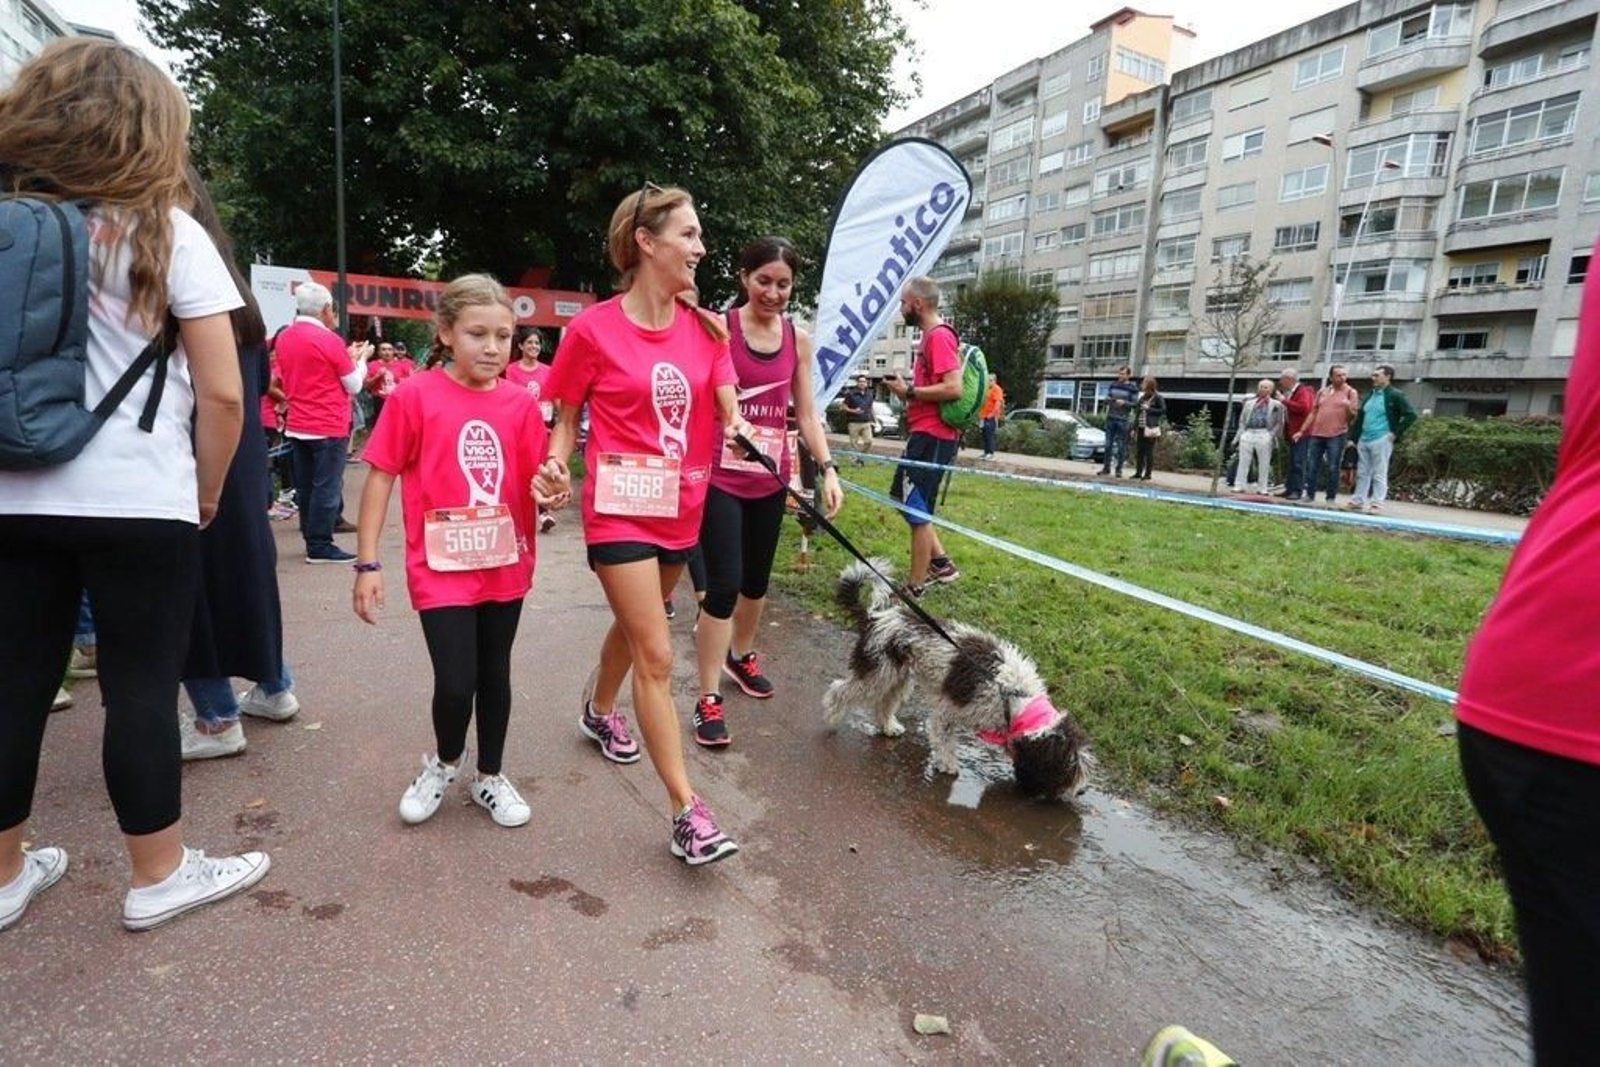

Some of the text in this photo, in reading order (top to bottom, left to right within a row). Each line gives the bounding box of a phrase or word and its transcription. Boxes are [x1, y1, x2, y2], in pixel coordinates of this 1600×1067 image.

[815, 181, 956, 391] Atlántico
[332, 282, 442, 312] RUNRU
[658, 385, 685, 396] VIGO
[739, 404, 784, 417] UNNIN
[469, 427, 485, 440] VI
[465, 446, 495, 456] VIGO
[612, 473, 664, 499] 5668
[445, 526, 499, 553] 5667
